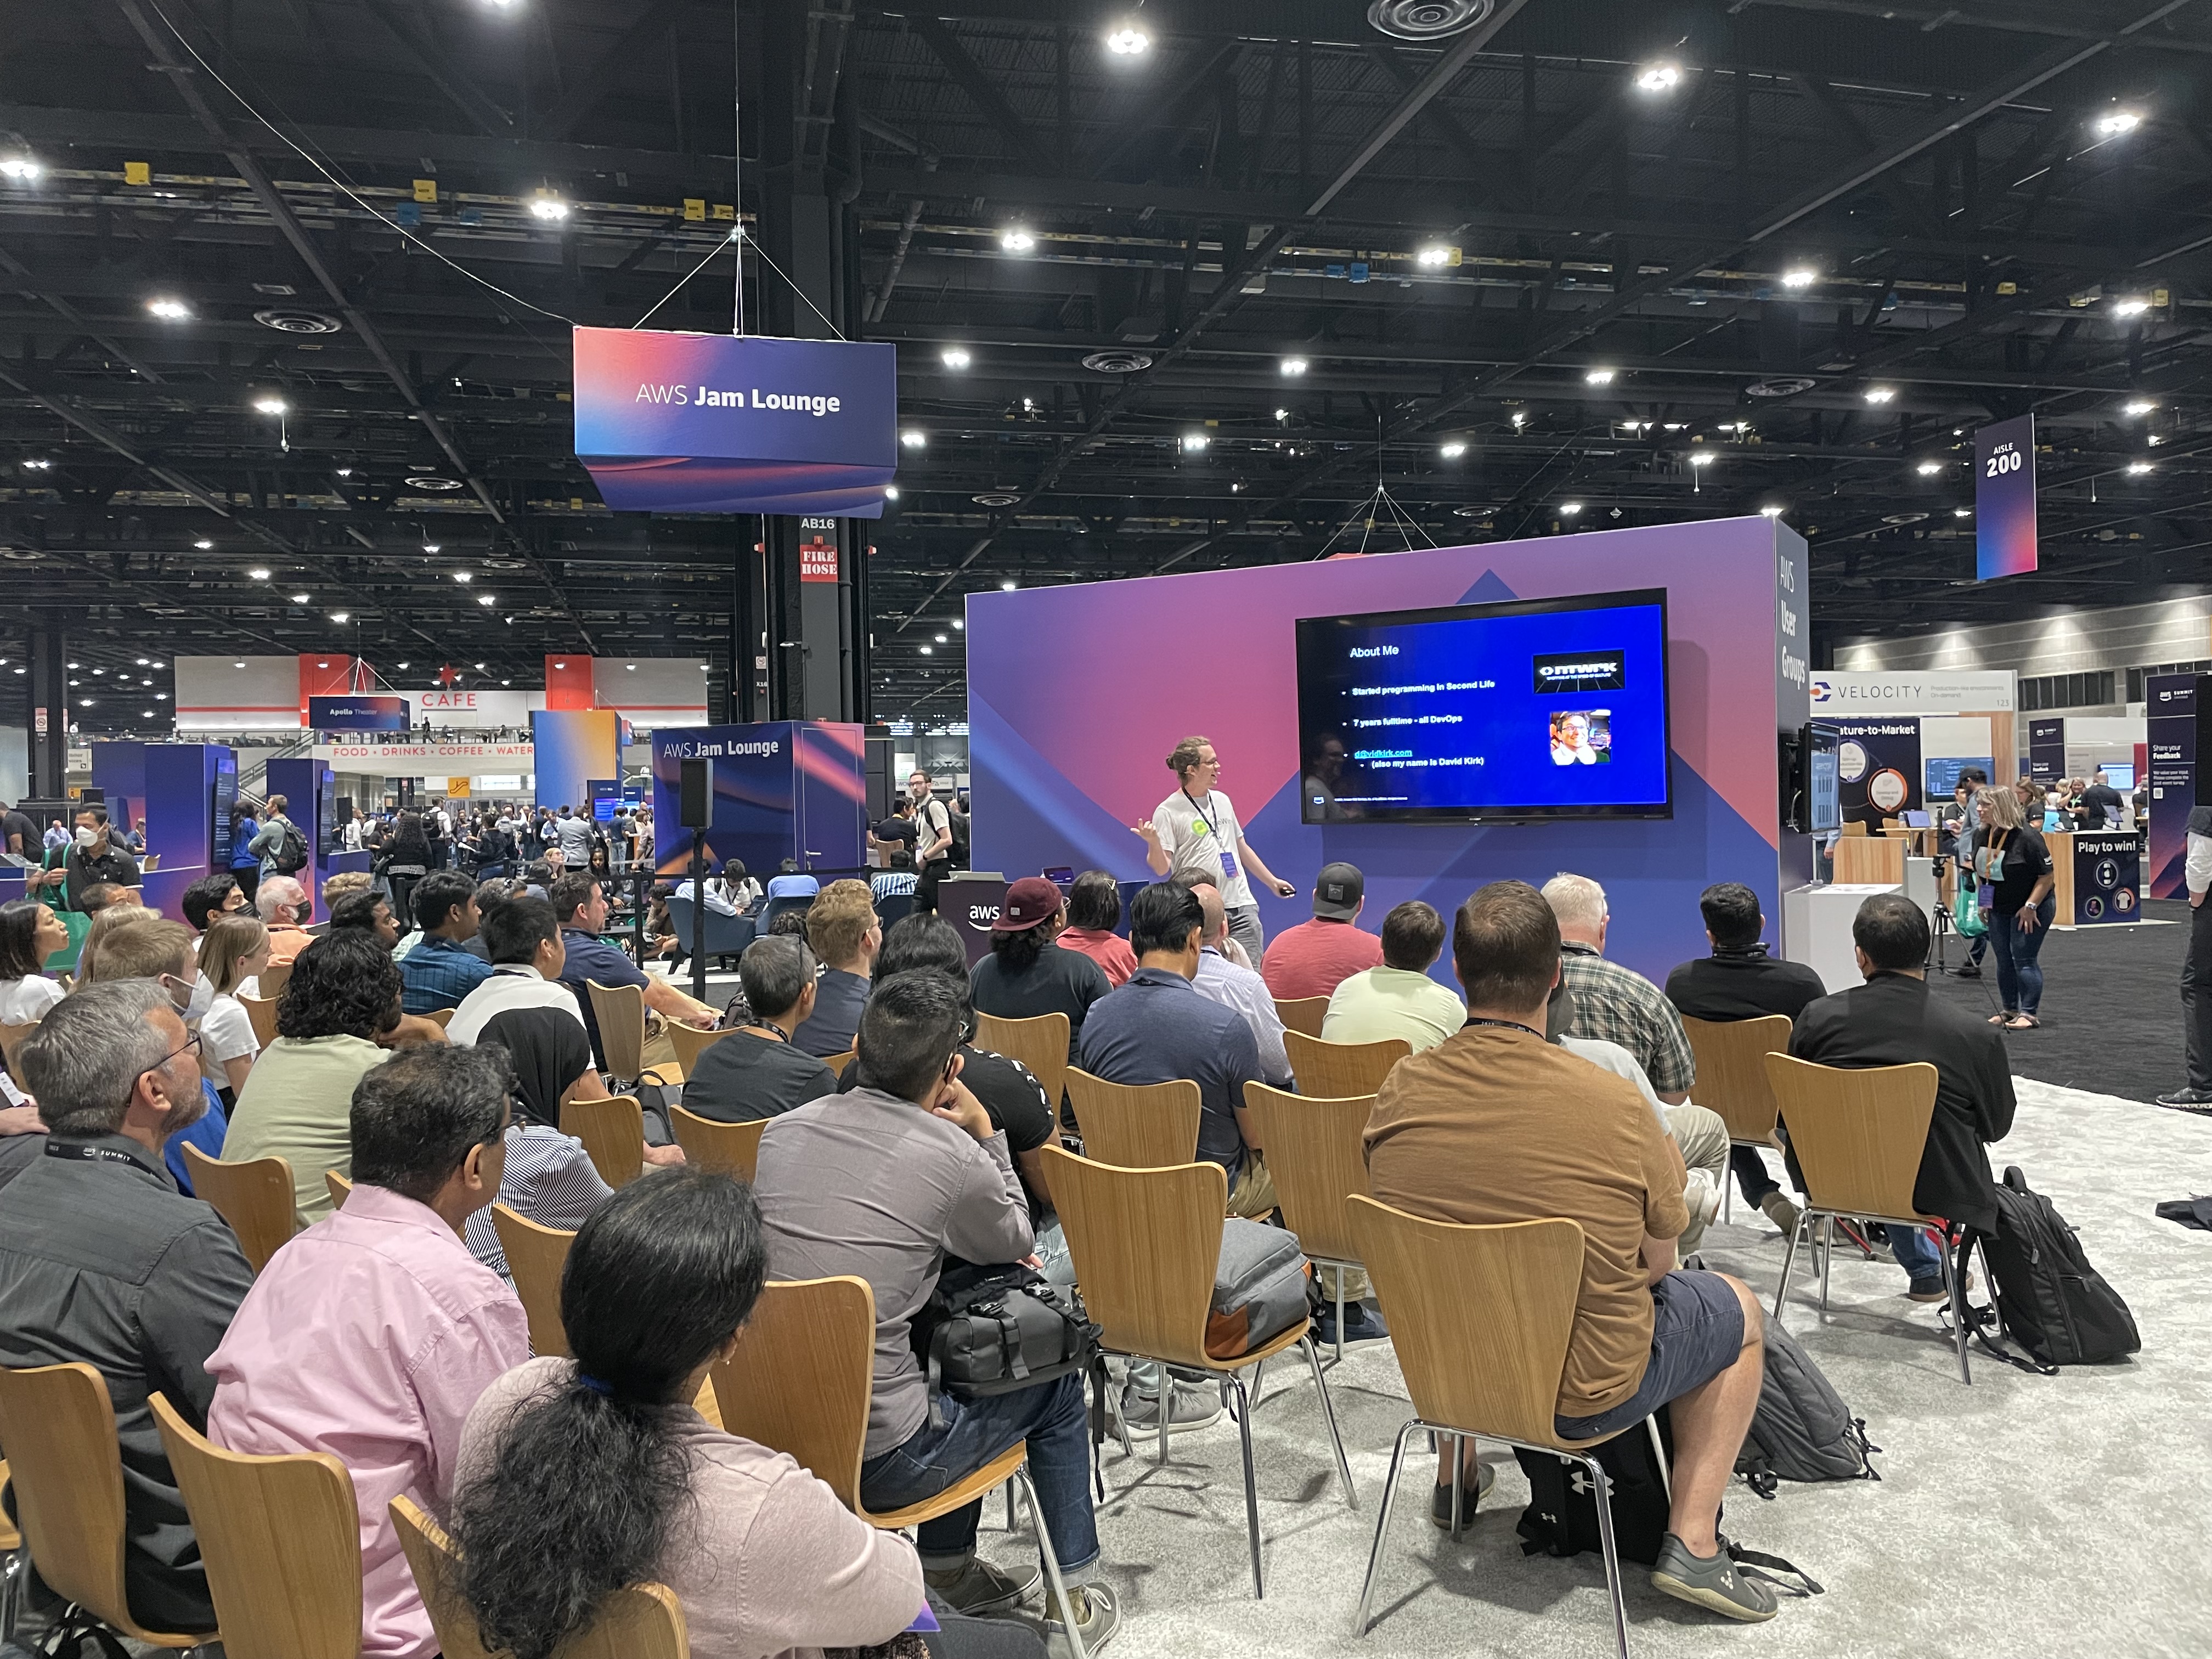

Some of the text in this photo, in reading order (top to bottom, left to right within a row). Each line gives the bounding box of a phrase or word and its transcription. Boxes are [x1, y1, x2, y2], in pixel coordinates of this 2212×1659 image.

[635, 383, 840, 417] AWS Jam Lounge
[1993, 442, 2013, 455] AISLE
[1987, 451, 2022, 478] 200
[801, 518, 834, 529] AB16
[803, 551, 835, 562] FIRE
[802, 563, 837, 574] HOSE
[1780, 555, 1795, 593] AWS
[1781, 599, 1796, 636] User
[1350, 645, 1400, 658] About Me
[1782, 645, 1805, 690] Groups
[1352, 687, 1381, 696] Started
[1382, 684, 1436, 696] programming
[1446, 681, 1478, 690] Second
[1479, 680, 1496, 688] Life
[1838, 686, 1922, 698] VELOCITY
[422, 693, 476, 707] CAFE
[1359, 719, 1382, 728] years
[1383, 717, 1413, 726] fulltime
[1430, 715, 1463, 724] DevOps
[1840, 725, 1915, 735] ature-to-Market
[334, 746, 533, 757] FOOD DRINKS COFFEE WATER
[663, 740, 779, 758] AWS Jam Lounge
[2169, 745, 2181, 753] your
[1372, 760, 1391, 769] (also
[1438, 758, 1463, 766] David
[1464, 757, 1485, 766] Kirk)
[2078, 840, 2136, 855] Play to win!
[969, 905, 1001, 920] aws
[100, 1150, 131, 1161] SUMMIT
